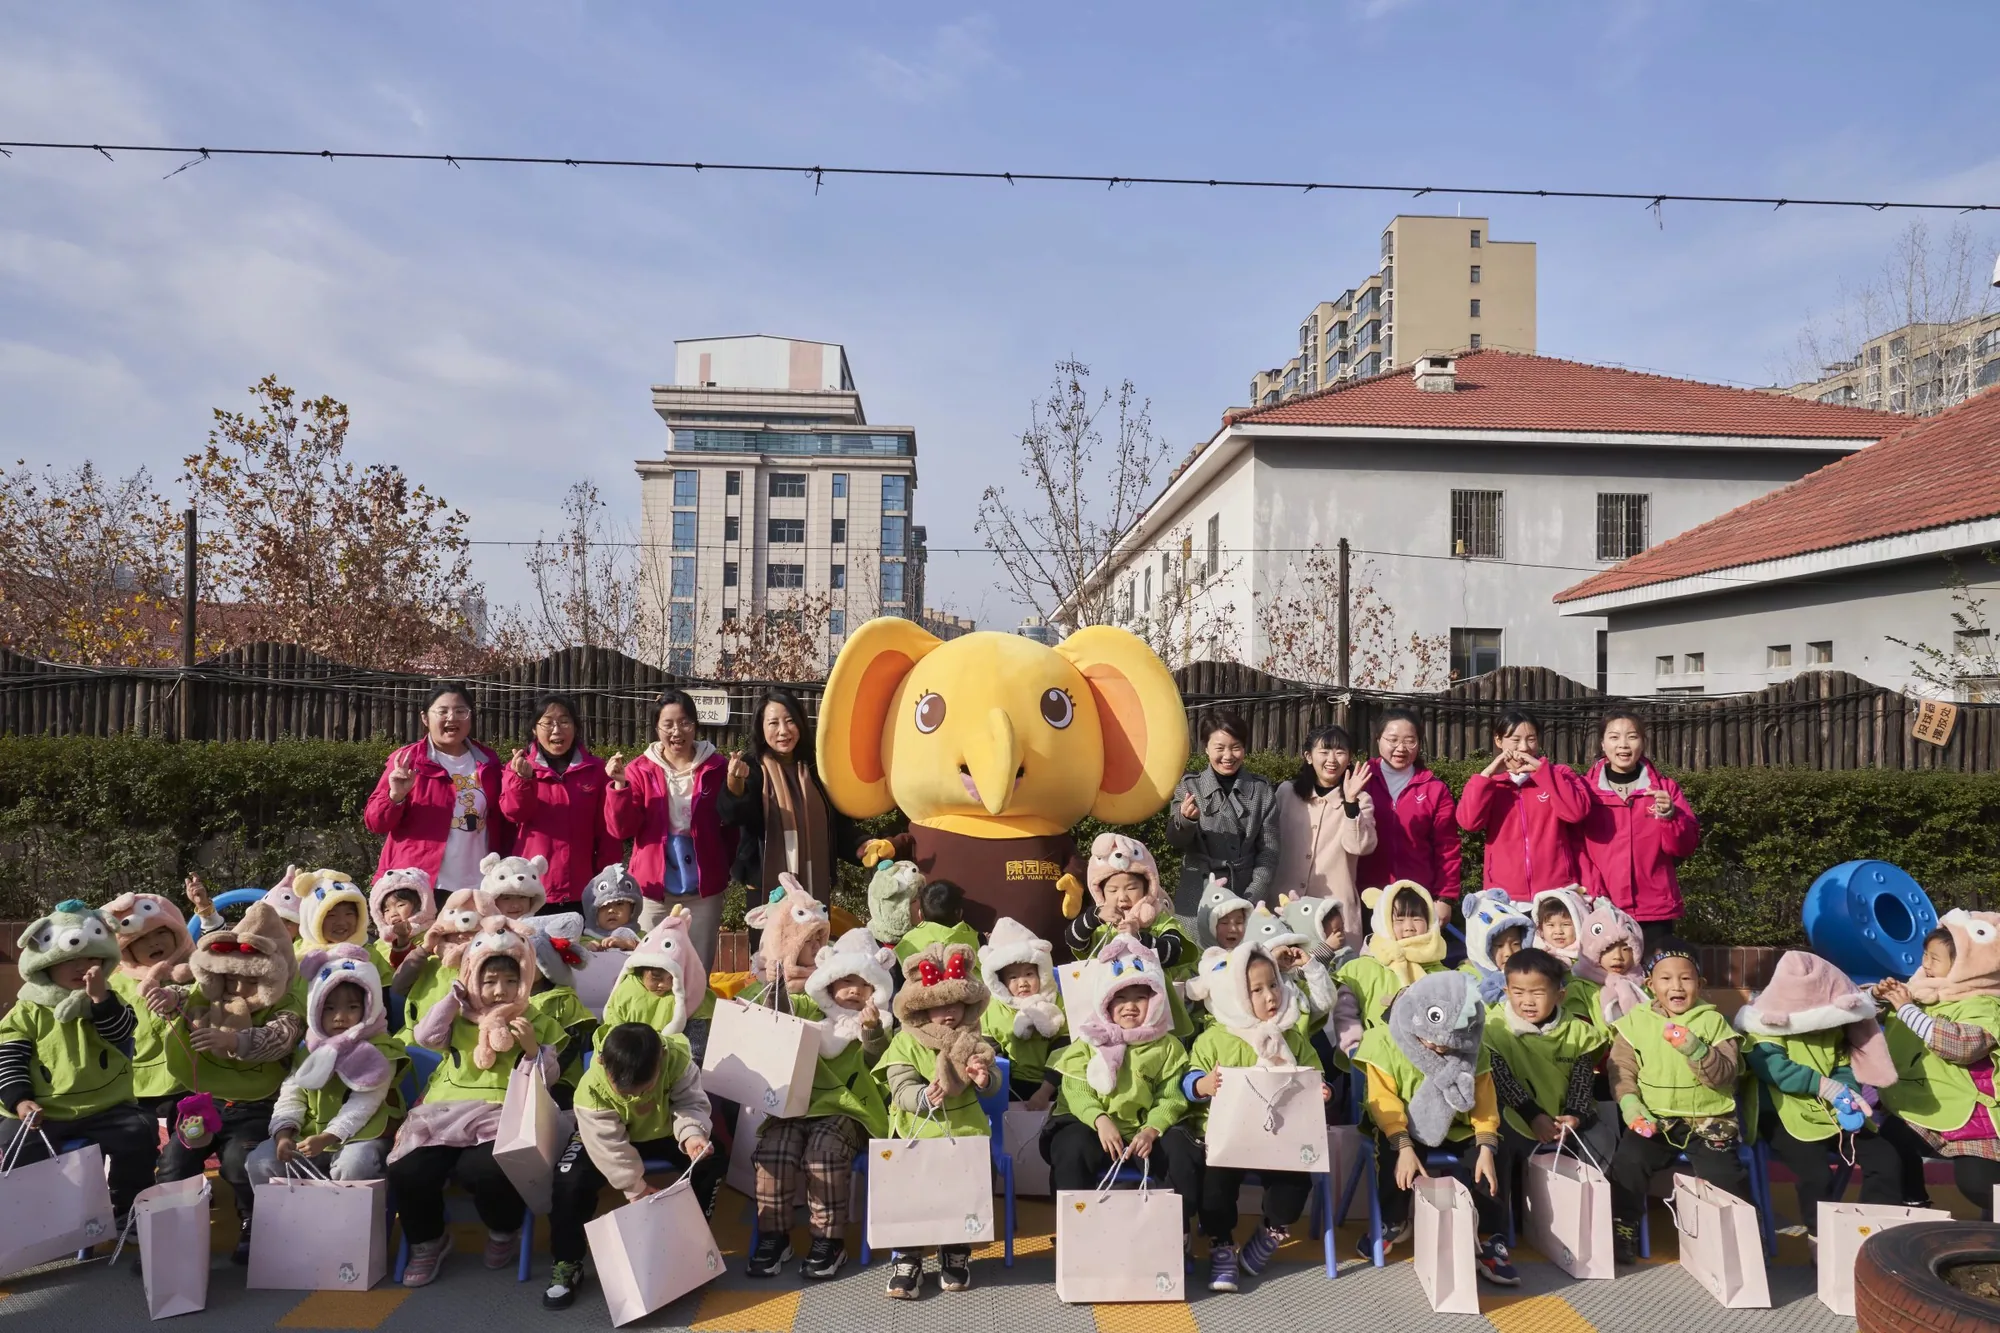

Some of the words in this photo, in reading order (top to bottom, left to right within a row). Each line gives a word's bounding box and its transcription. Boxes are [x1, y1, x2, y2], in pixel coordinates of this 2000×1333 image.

[1917, 702, 1936, 736] 投球器
[1931, 707, 1951, 741] 摆放处
